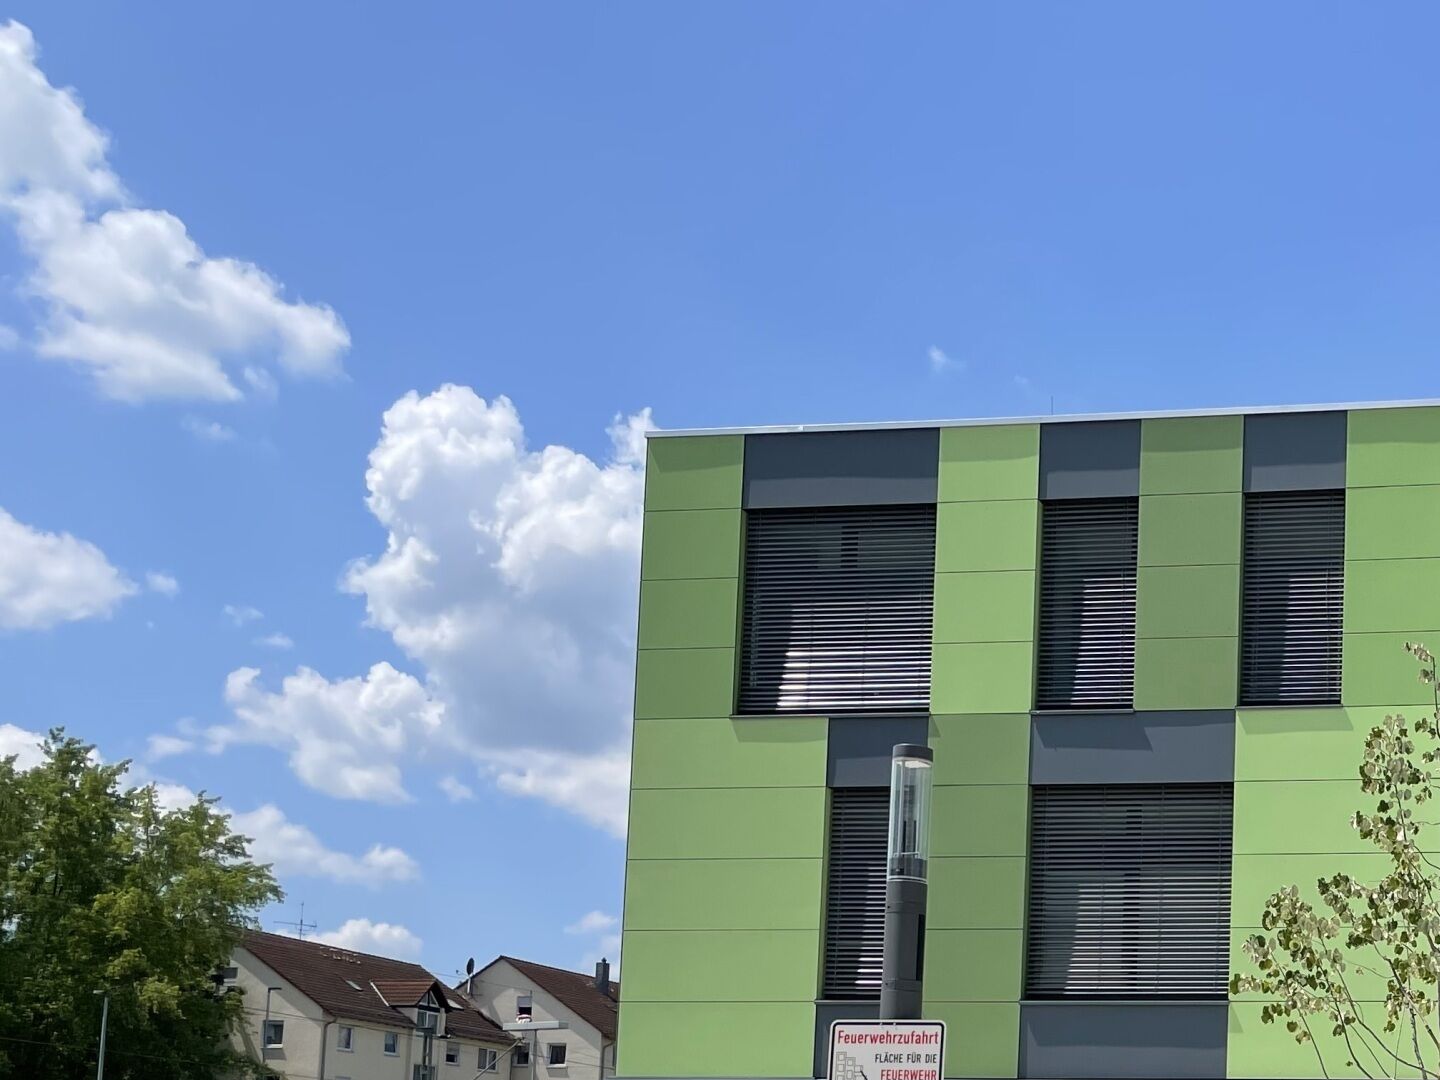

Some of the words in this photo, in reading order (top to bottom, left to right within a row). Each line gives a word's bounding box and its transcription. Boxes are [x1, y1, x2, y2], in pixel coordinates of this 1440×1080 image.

[837, 1030, 939, 1045] Feuerwehrzufahrt
[874, 1052, 903, 1064] FLÄCHE
[906, 1052, 922, 1064] FÜR
[925, 1053, 937, 1064] DIE
